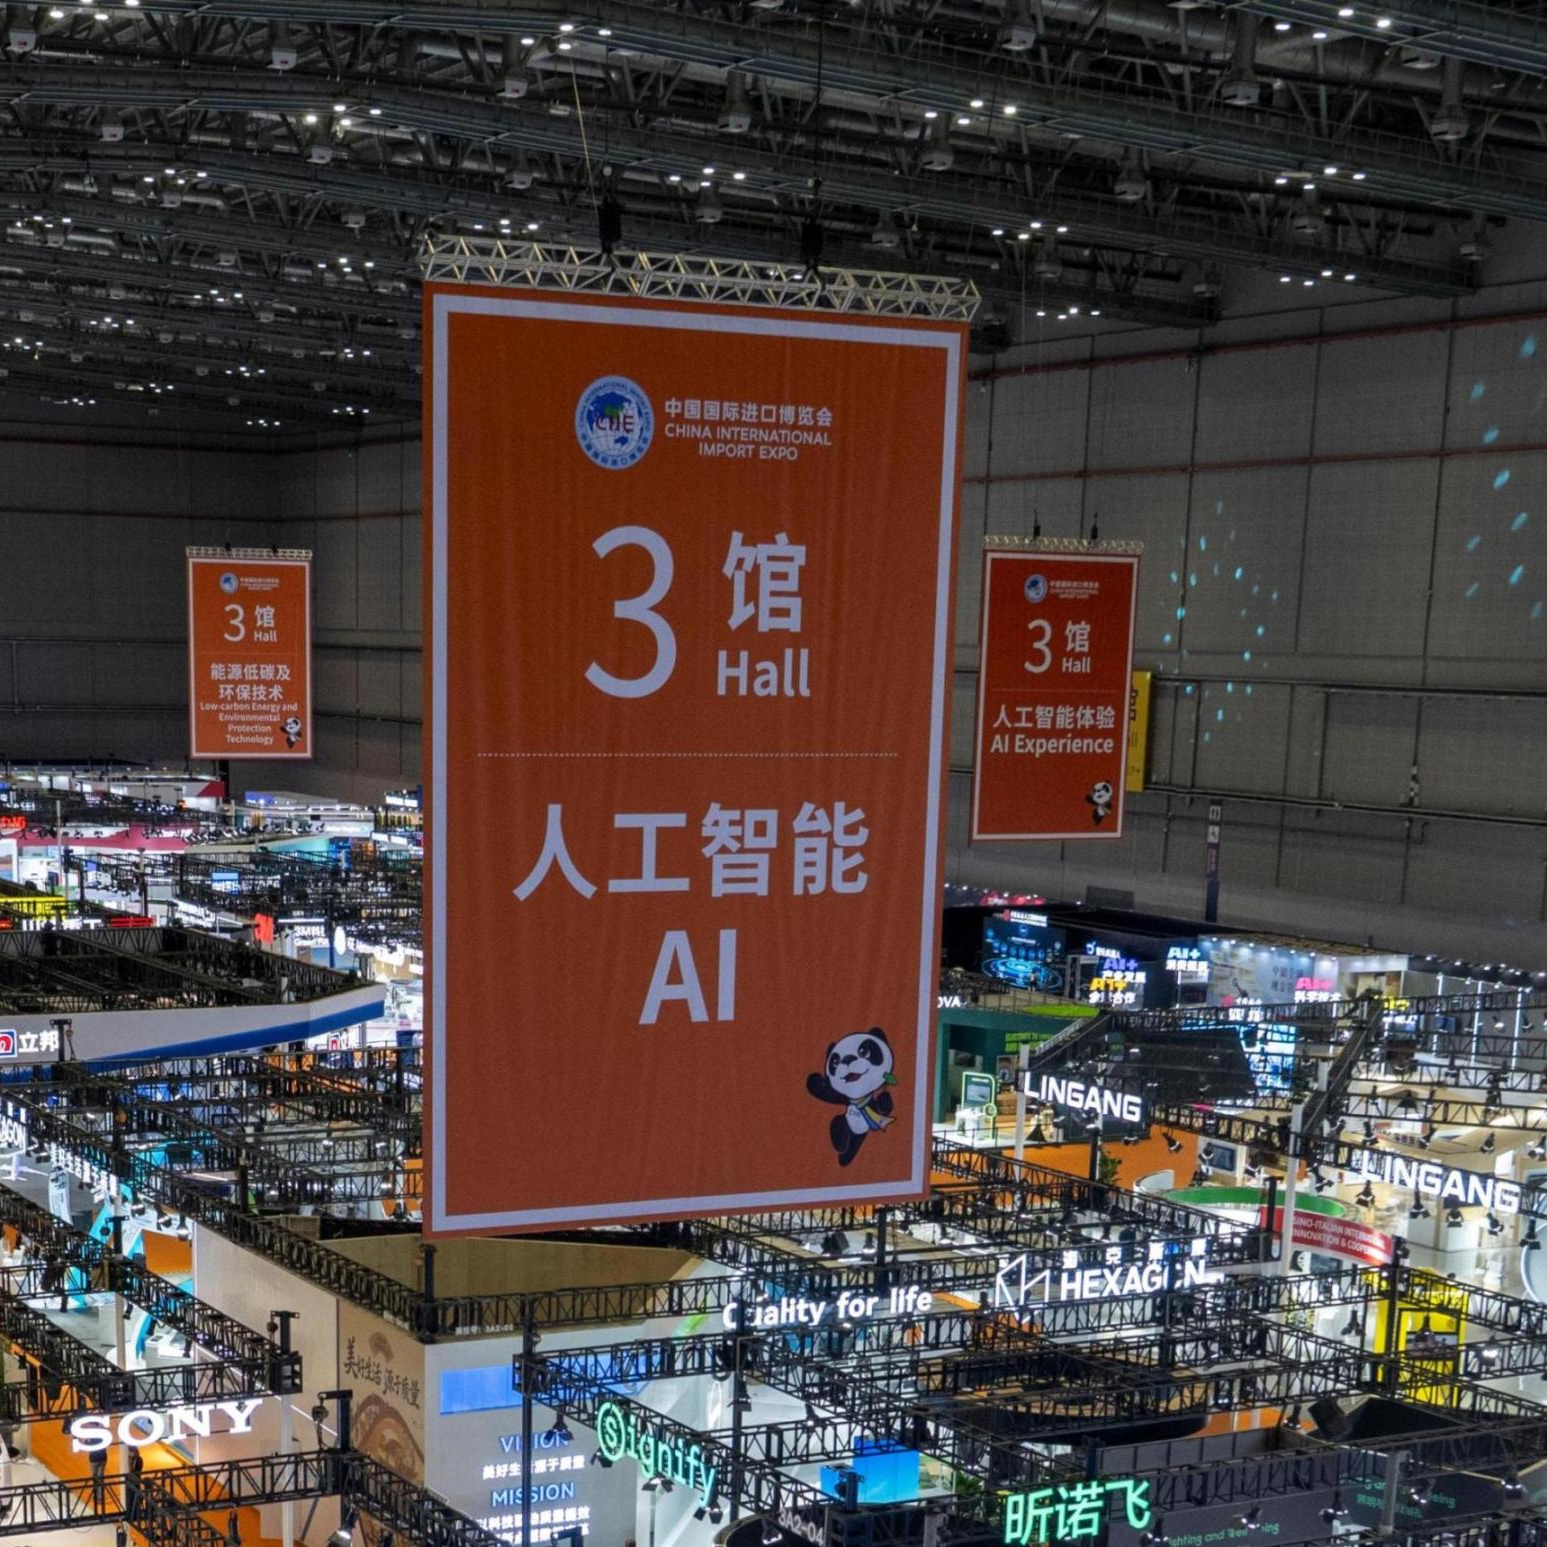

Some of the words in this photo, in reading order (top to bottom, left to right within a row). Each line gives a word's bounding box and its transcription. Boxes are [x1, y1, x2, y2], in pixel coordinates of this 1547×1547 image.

[665, 398, 832, 426] 中国国际进口博览会
[665, 424, 712, 439] CHINA
[717, 427, 832, 446] INTERNATIONAL
[699, 442, 754, 458] IMPORT
[759, 446, 798, 460] EXPO
[224, 604, 246, 642] 3
[254, 605, 276, 628] 馆
[584, 525, 677, 698] 3
[722, 532, 807, 634] 馆
[254, 630, 277, 642] Hall
[1023, 618, 1052, 674] 3
[1064, 620, 1091, 653] 馆
[210, 663, 292, 681] 能源低碳及
[716, 647, 810, 698] Hall
[1062, 657, 1091, 674] Hall
[218, 683, 283, 701] 环保技术
[200, 702, 250, 711] Low-carbon
[251, 702, 281, 713] Energy
[282, 702, 298, 712] and
[218, 712, 281, 722] Environmental
[992, 704, 1116, 729] 人工智能体验
[225, 734, 274, 745] Technology
[227, 723, 272, 733] Protection
[990, 734, 1009, 753] AI
[1014, 733, 1114, 758] Experience
[514, 801, 870, 902] 人工智能
[639, 928, 738, 1026] AI
[18, 1030, 60, 1054] 立邦
[1024, 1071, 1143, 1124] LINGANG
[1362, 1150, 1521, 1214] LINGANG
[836, 1290, 879, 1321] for
[889, 1285, 934, 1315] life
[71, 1397, 265, 1454] SONY
[500, 1432, 570, 1453] VIION
[482, 1454, 586, 1480] 美好生源于质量
[1004, 1478, 1152, 1546] 昕诺飞
[778, 1507, 825, 1547] 3A2-04
